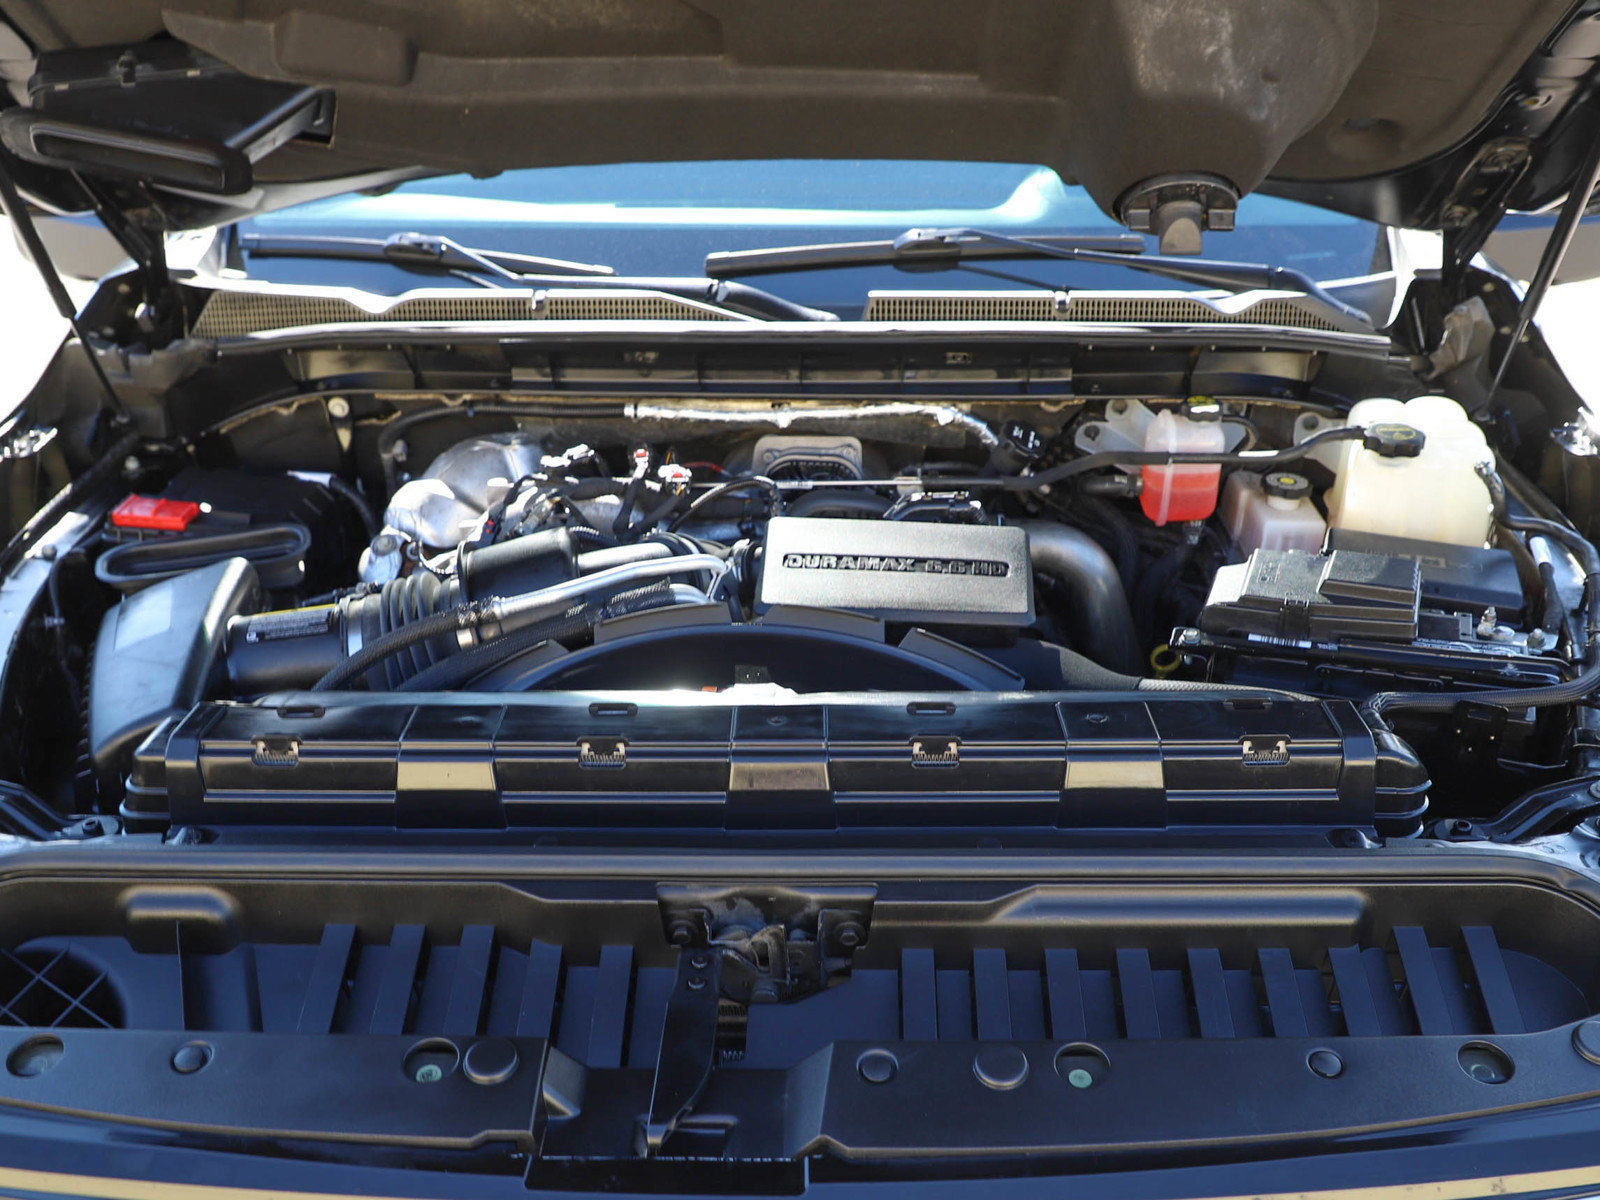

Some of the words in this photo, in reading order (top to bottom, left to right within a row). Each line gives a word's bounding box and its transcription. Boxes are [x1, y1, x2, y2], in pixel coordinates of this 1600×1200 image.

[785, 554, 916, 572] DURAMAX
[925, 560, 967, 574] 6.6
[972, 561, 1006, 576] HD
